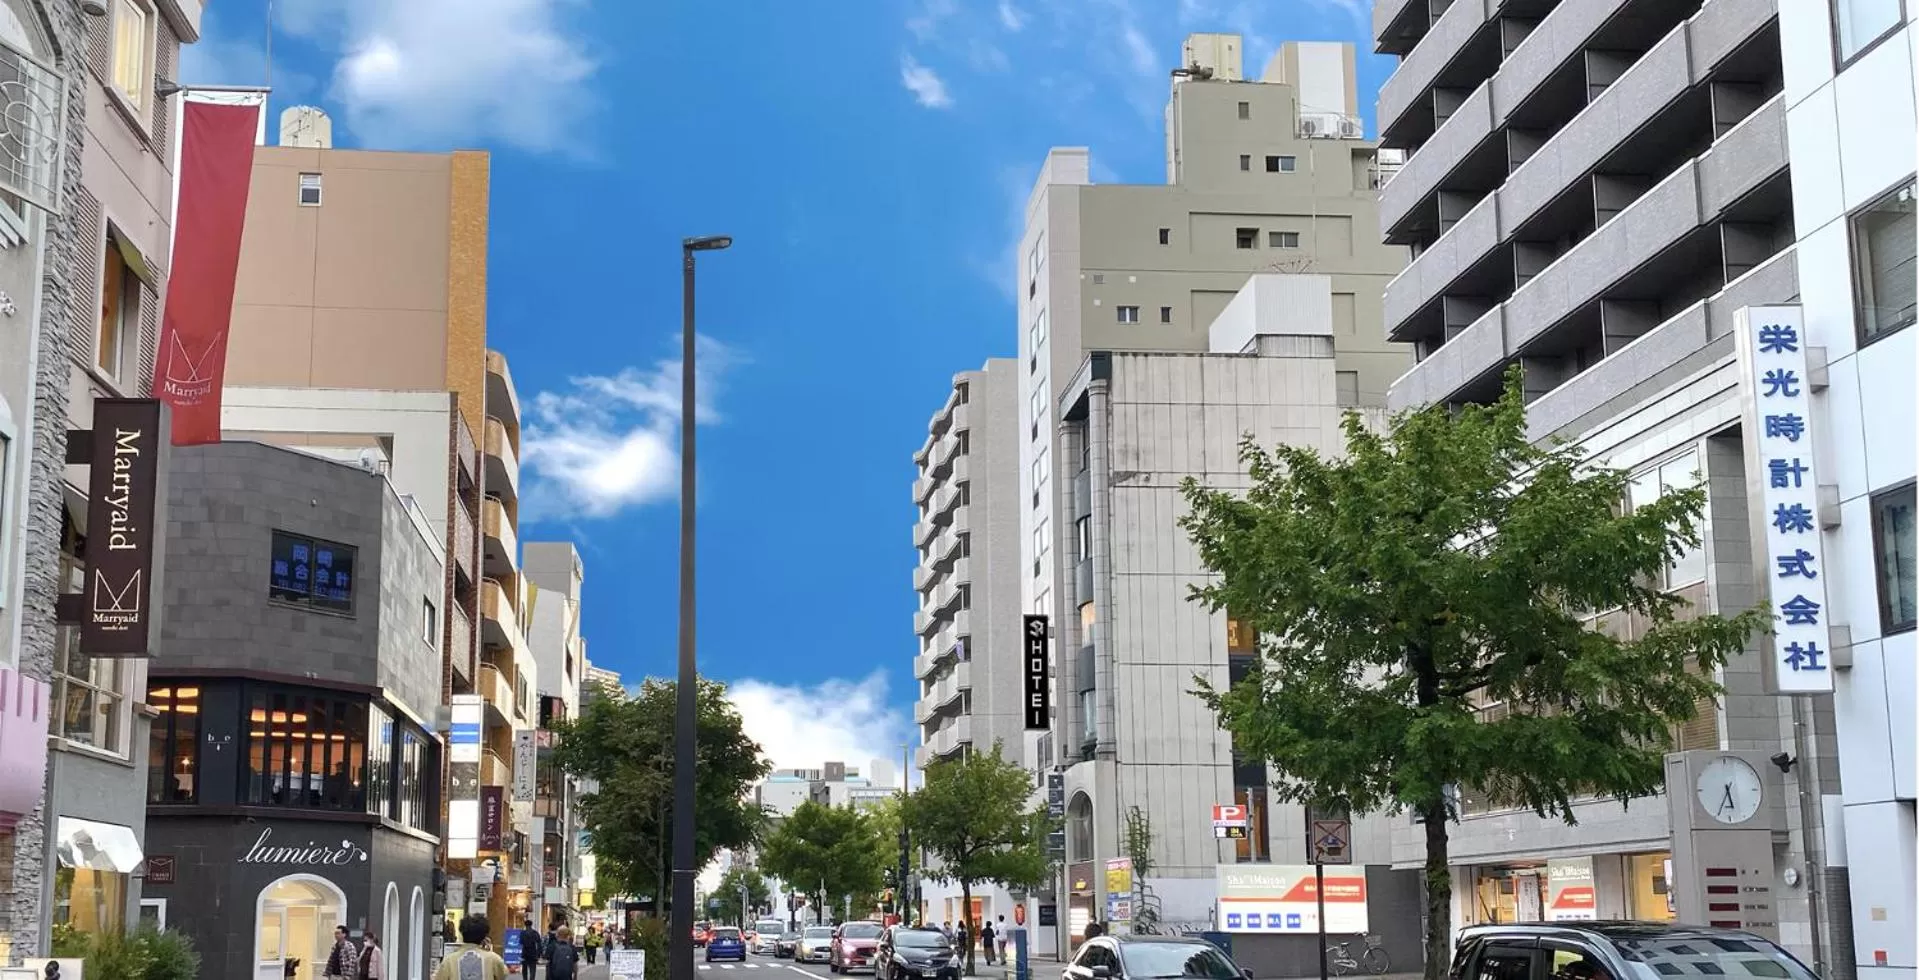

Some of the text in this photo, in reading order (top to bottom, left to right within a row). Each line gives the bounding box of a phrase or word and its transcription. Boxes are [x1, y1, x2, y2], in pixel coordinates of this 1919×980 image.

[104, 428, 141, 551] Marryaid
[1758, 324, 1826, 672] 栄光時計株式会社
[92, 613, 138, 624] Marryaid
[1220, 806, 1240, 821] P
